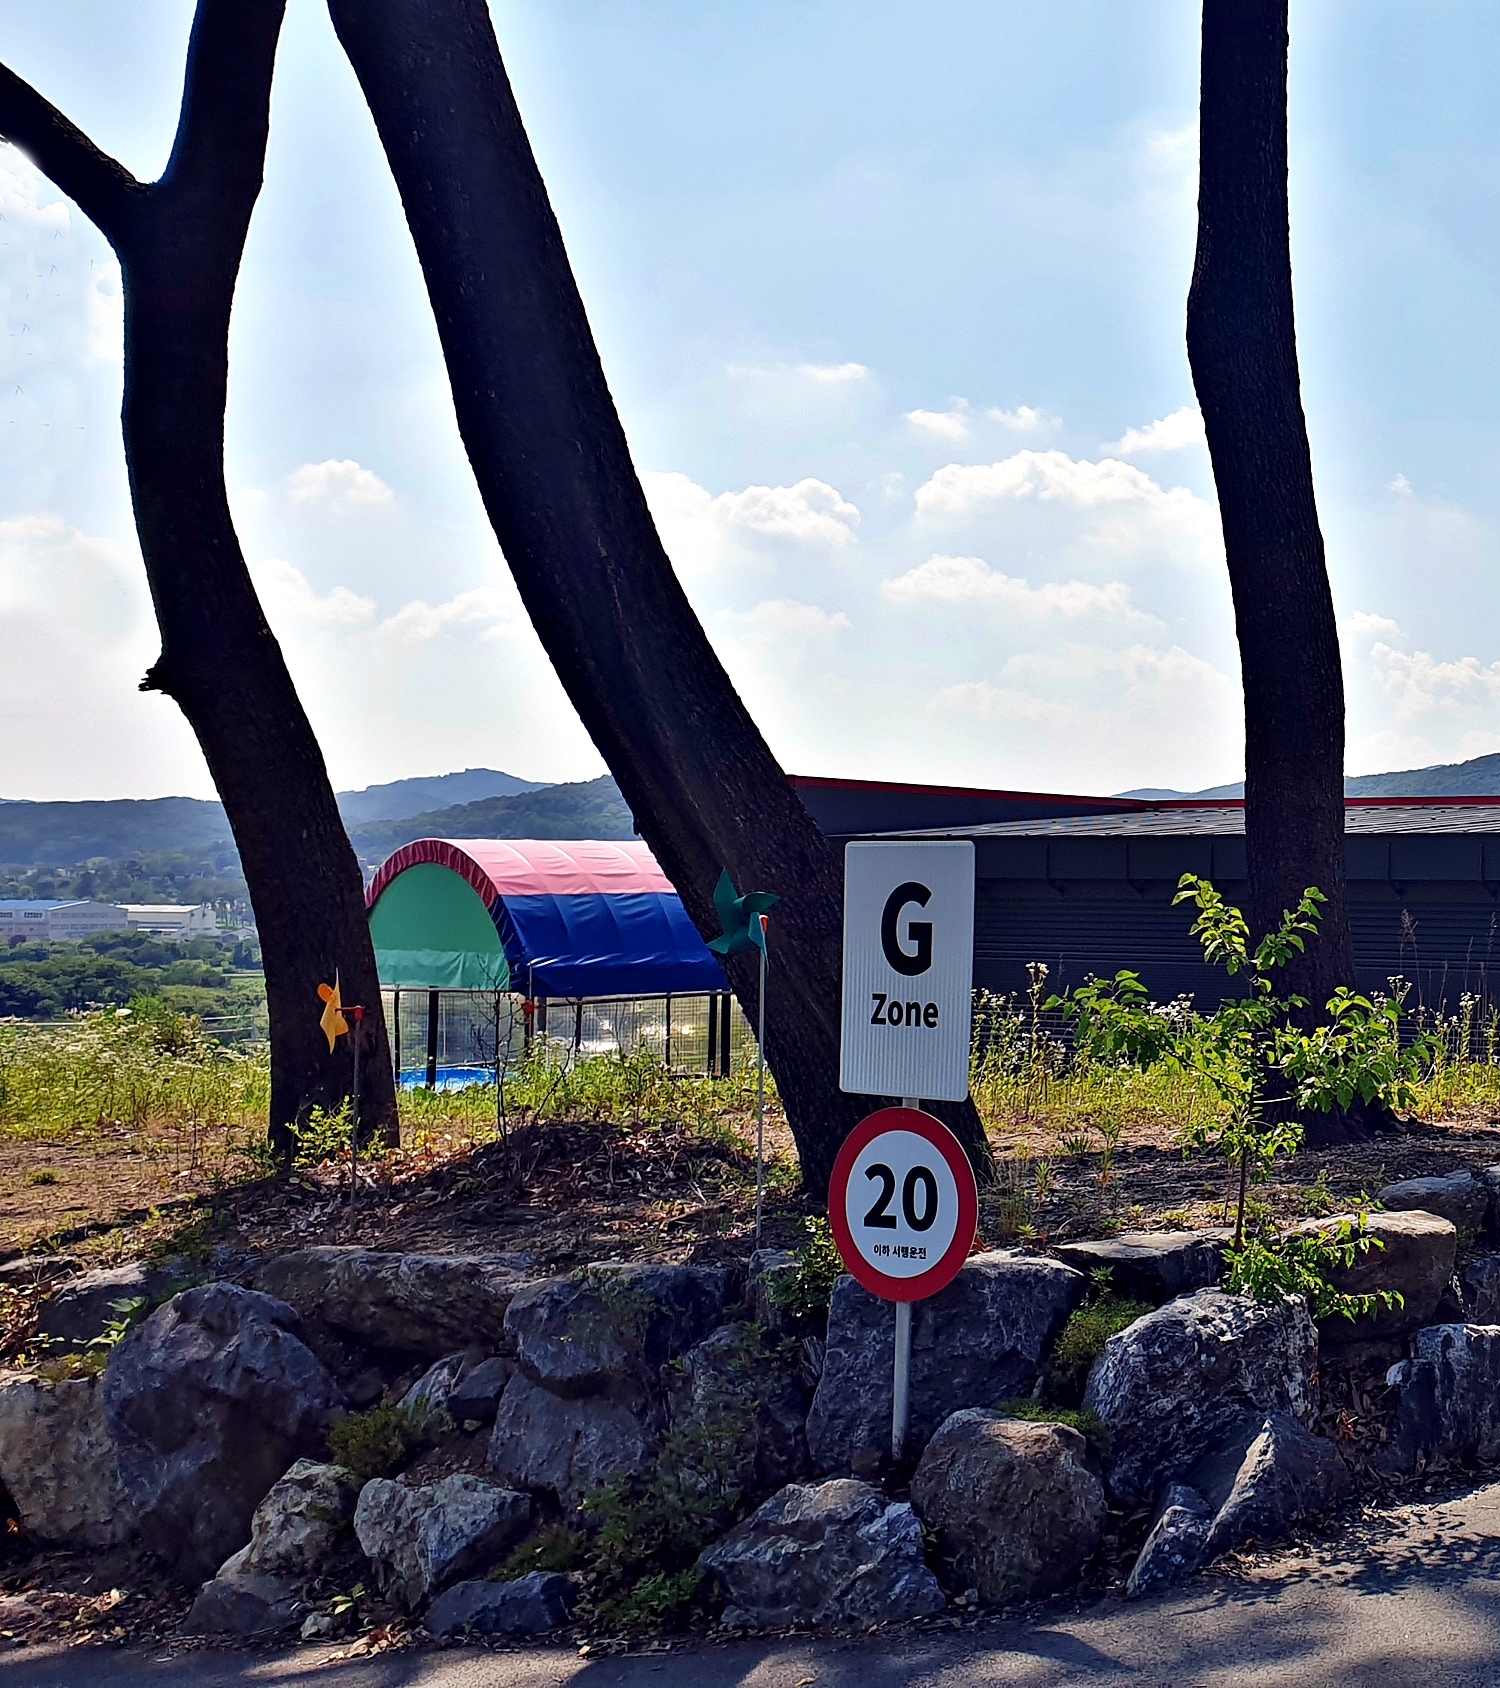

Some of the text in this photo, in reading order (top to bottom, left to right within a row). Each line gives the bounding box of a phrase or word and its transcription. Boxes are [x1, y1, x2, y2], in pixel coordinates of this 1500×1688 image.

[880, 880, 933, 977] G
[870, 992, 939, 1029] Zone
[863, 1162, 939, 1233] 20
[873, 1244, 927, 1260] 이하 서행운전
